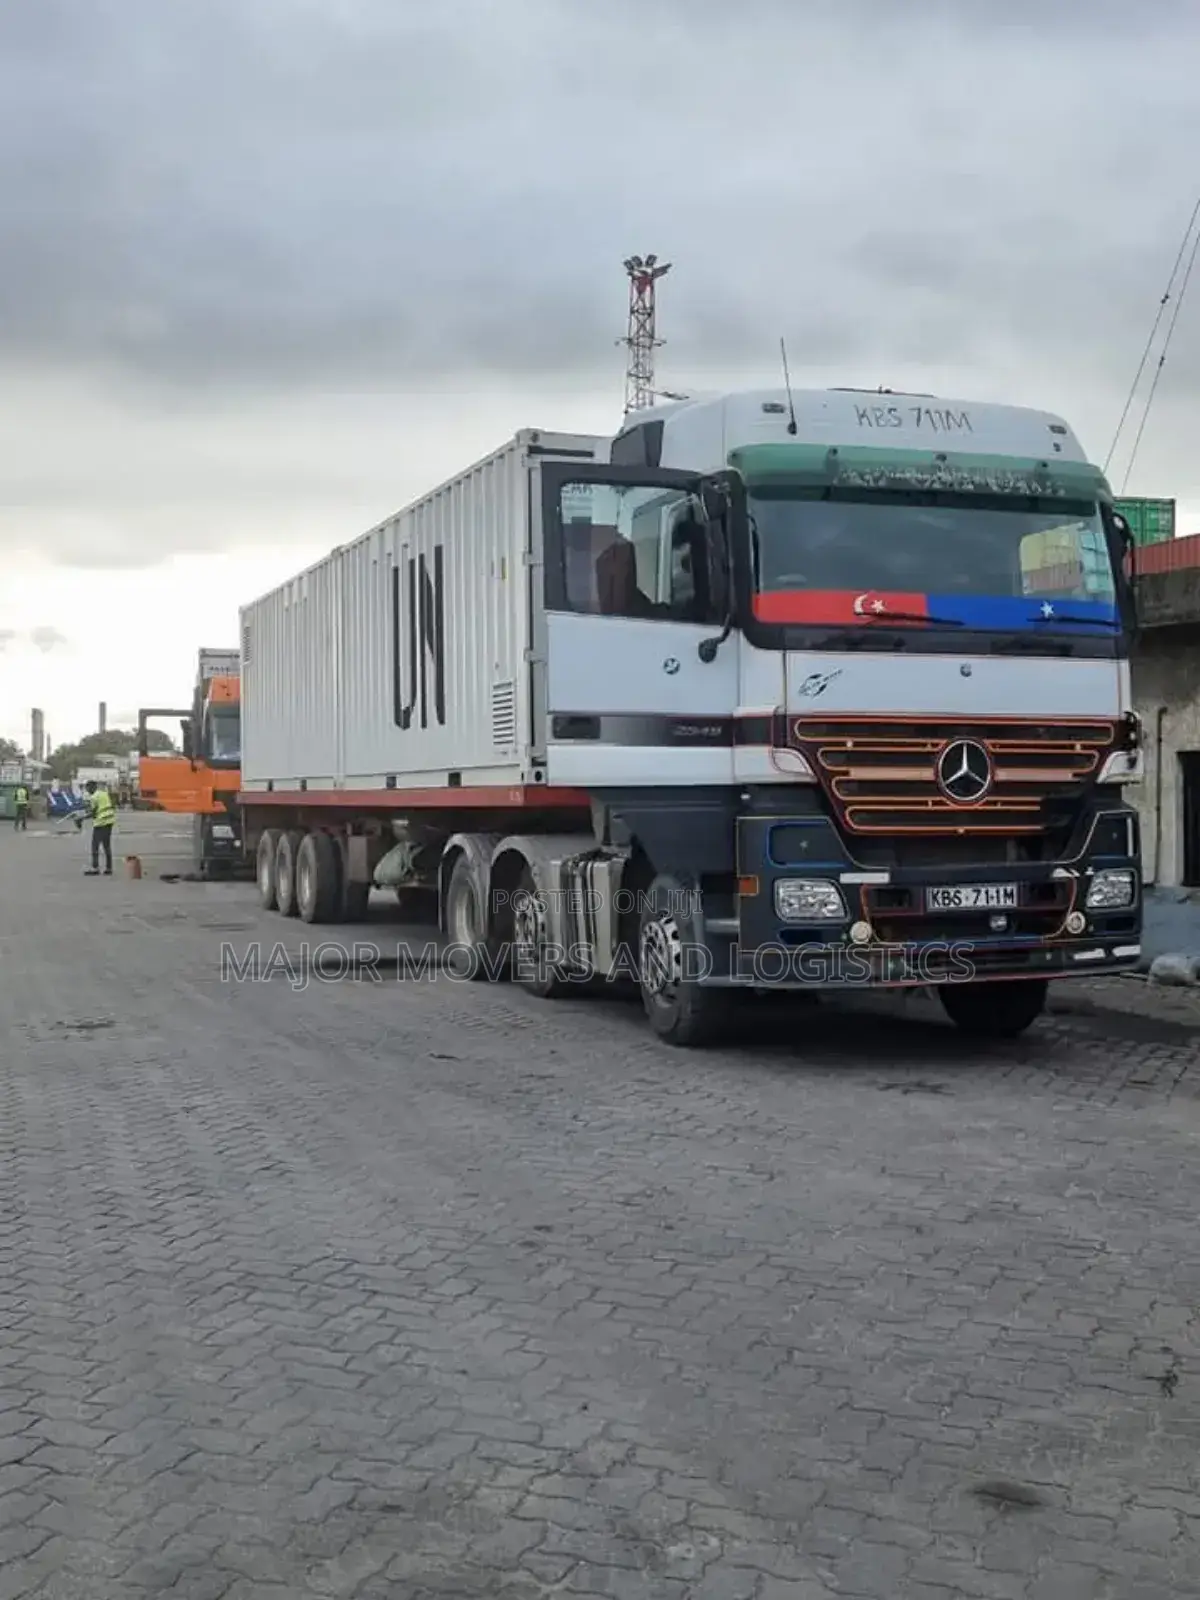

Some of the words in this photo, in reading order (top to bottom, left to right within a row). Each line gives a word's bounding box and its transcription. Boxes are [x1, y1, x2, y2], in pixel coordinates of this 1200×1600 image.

[854, 404, 902, 427] KBS
[908, 407, 973, 433] 711M
[393, 545, 445, 730] UN
[931, 889, 962, 907] KBS
